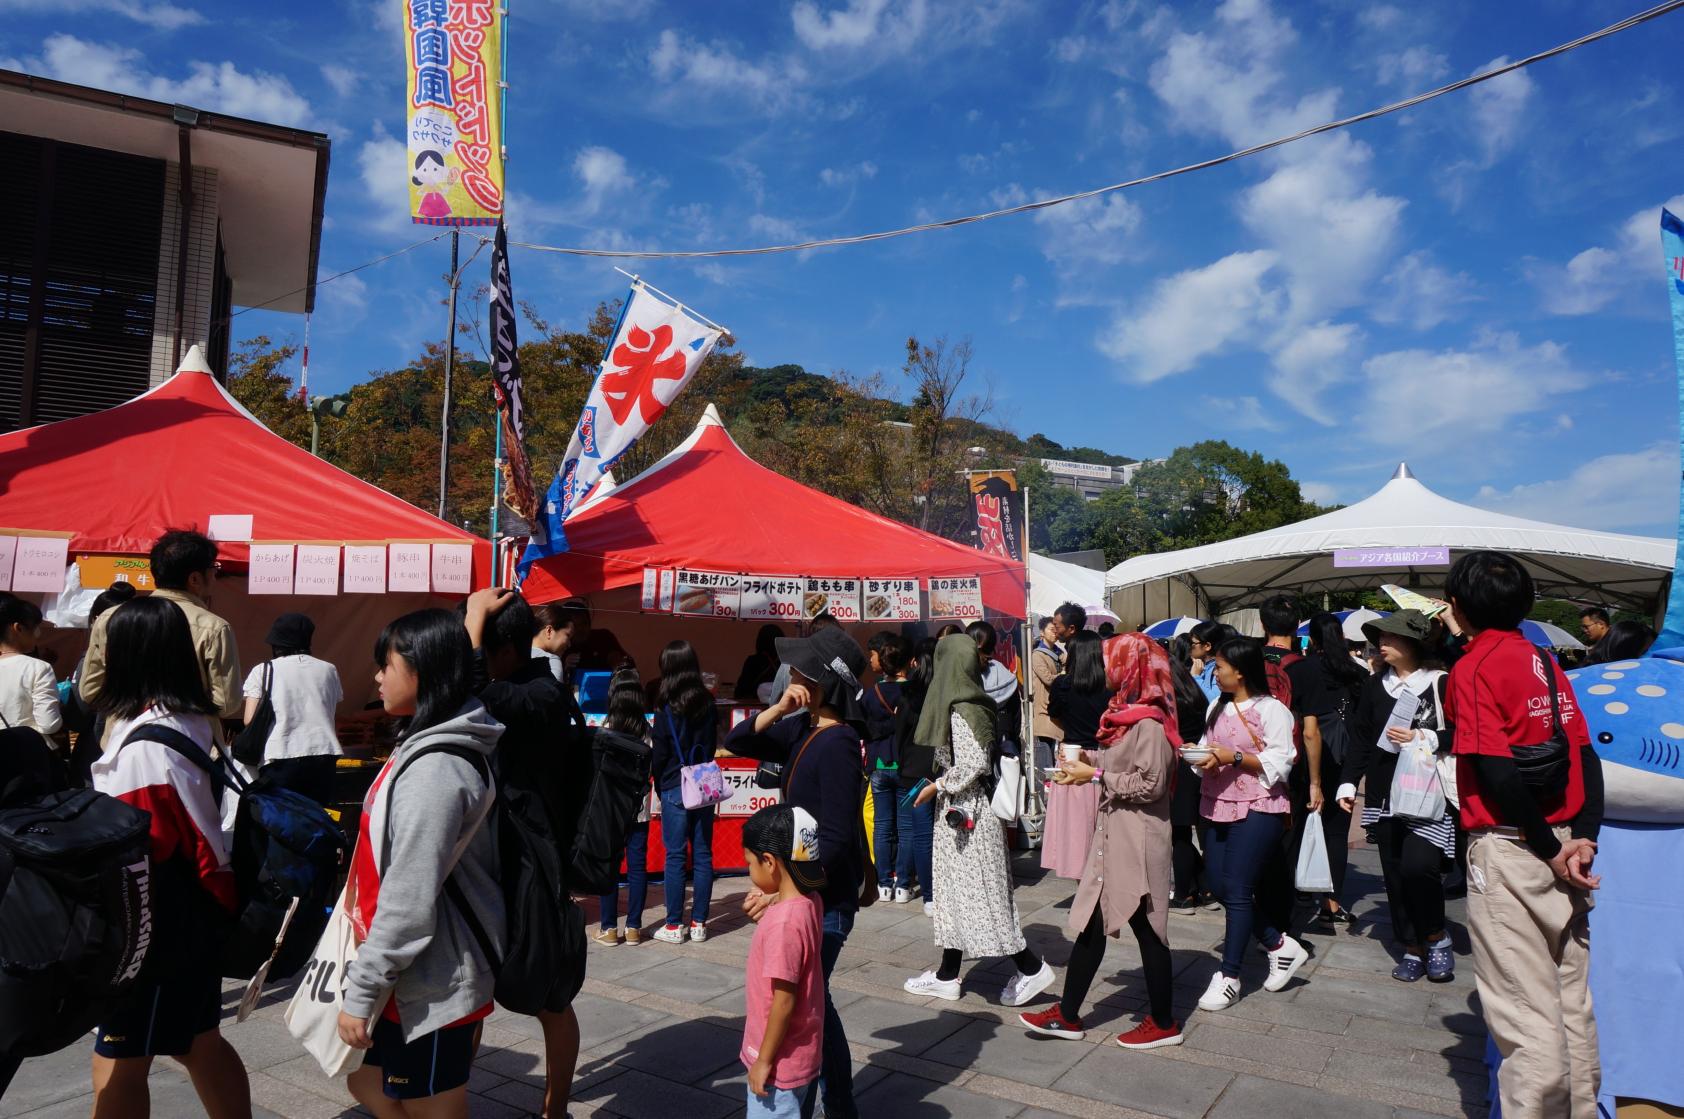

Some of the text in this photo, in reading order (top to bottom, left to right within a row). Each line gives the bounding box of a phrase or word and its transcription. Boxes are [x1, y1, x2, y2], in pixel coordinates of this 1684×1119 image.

[600, 322, 688, 426] 氷
[254, 553, 290, 563] からあげ
[1360, 550, 1445, 563] アジア各国紹介ブース
[678, 572, 739, 587] 黒糖あげパン
[807, 579, 855, 592] 鶏もも串
[931, 578, 978, 590] 鶏の炭火焼
[743, 580, 802, 595] フライドポテト
[869, 581, 914, 593] 砂ずり串
[769, 602, 801, 616] 300円
[830, 606, 858, 618] 300円
[954, 605, 981, 616] 500円
[118, 854, 152, 984] THRASHER
